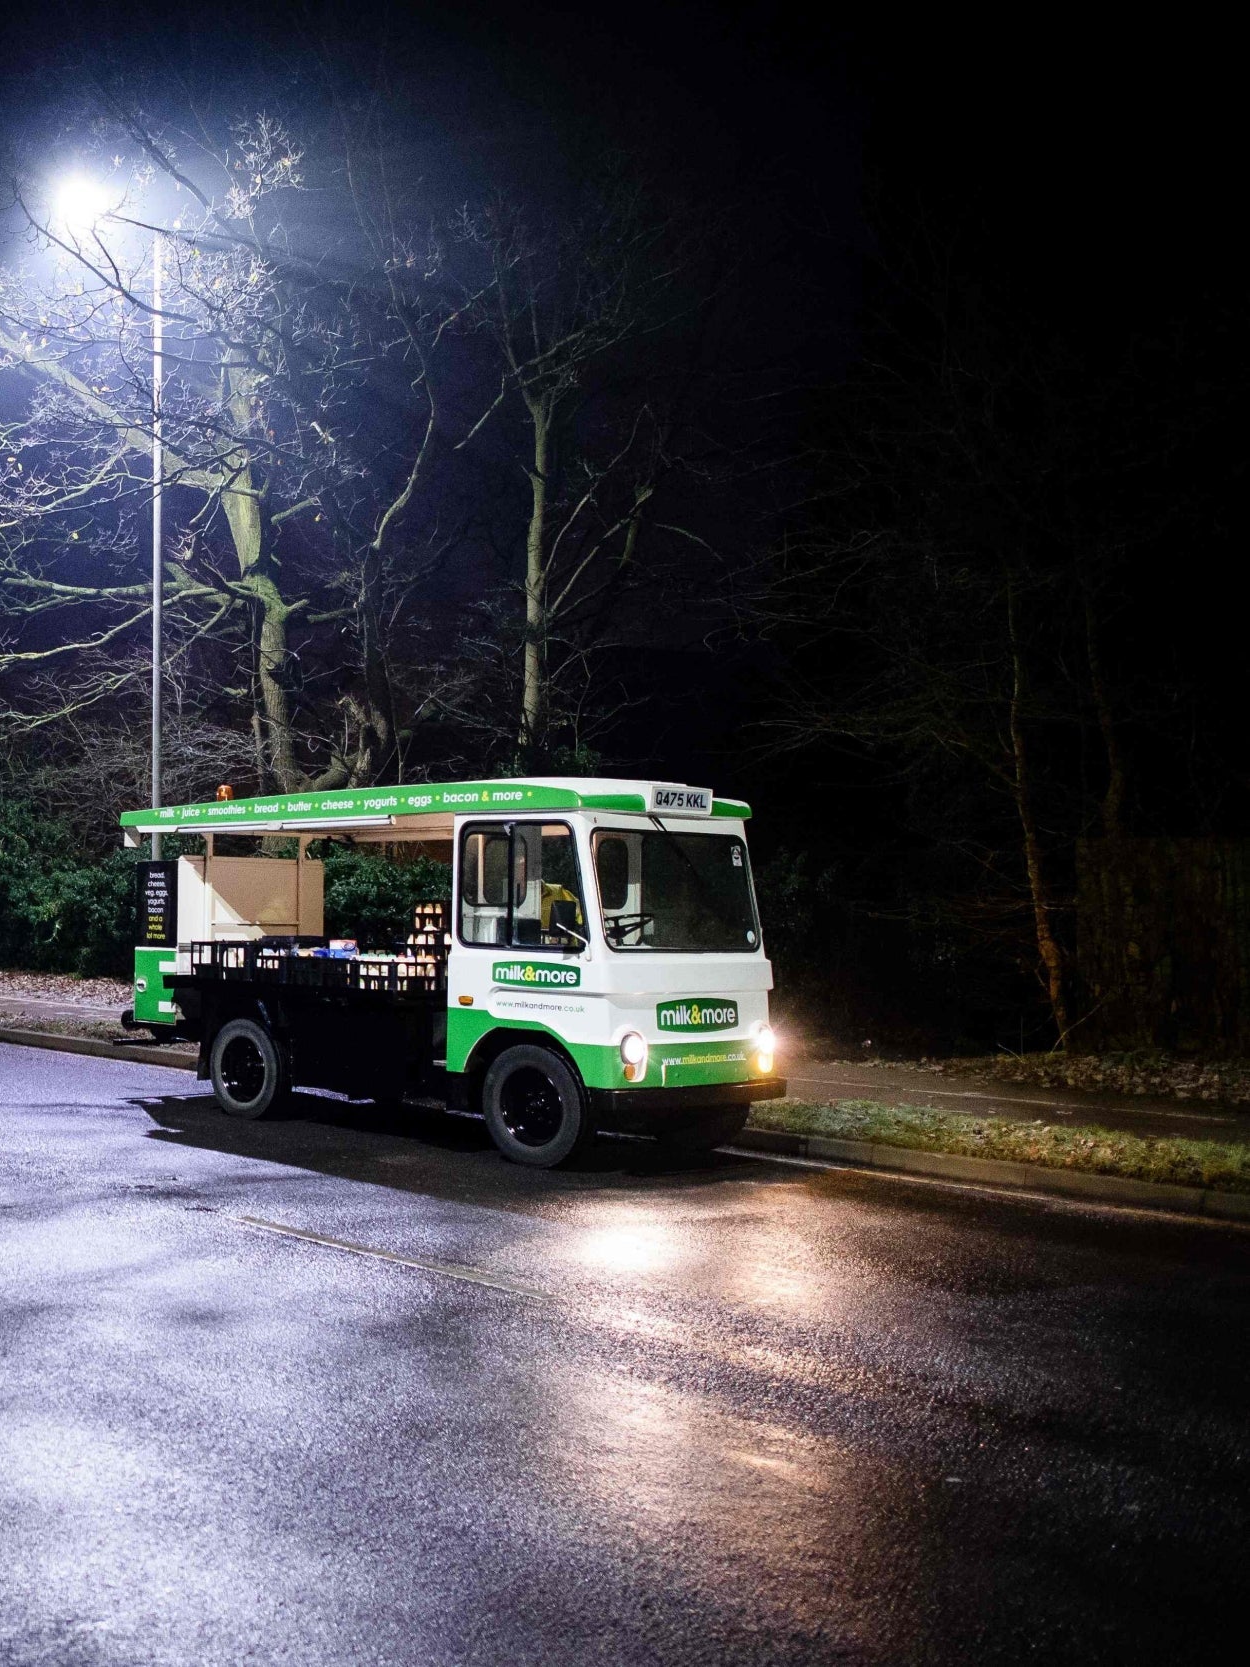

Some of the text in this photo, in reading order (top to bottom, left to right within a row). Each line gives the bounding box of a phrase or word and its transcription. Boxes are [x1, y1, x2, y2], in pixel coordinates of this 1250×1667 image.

[160, 791, 523, 820] milk juice smoothies bread butter cheese yogurts eggs bacon & more
[656, 791, 707, 809] Q475 KKL
[495, 965, 578, 985] milk&more
[496, 1000, 585, 1013] www.milkandmore.co.uk
[660, 1004, 736, 1026] milk&more
[661, 1051, 745, 1066] www.milkandmore.co.uk
